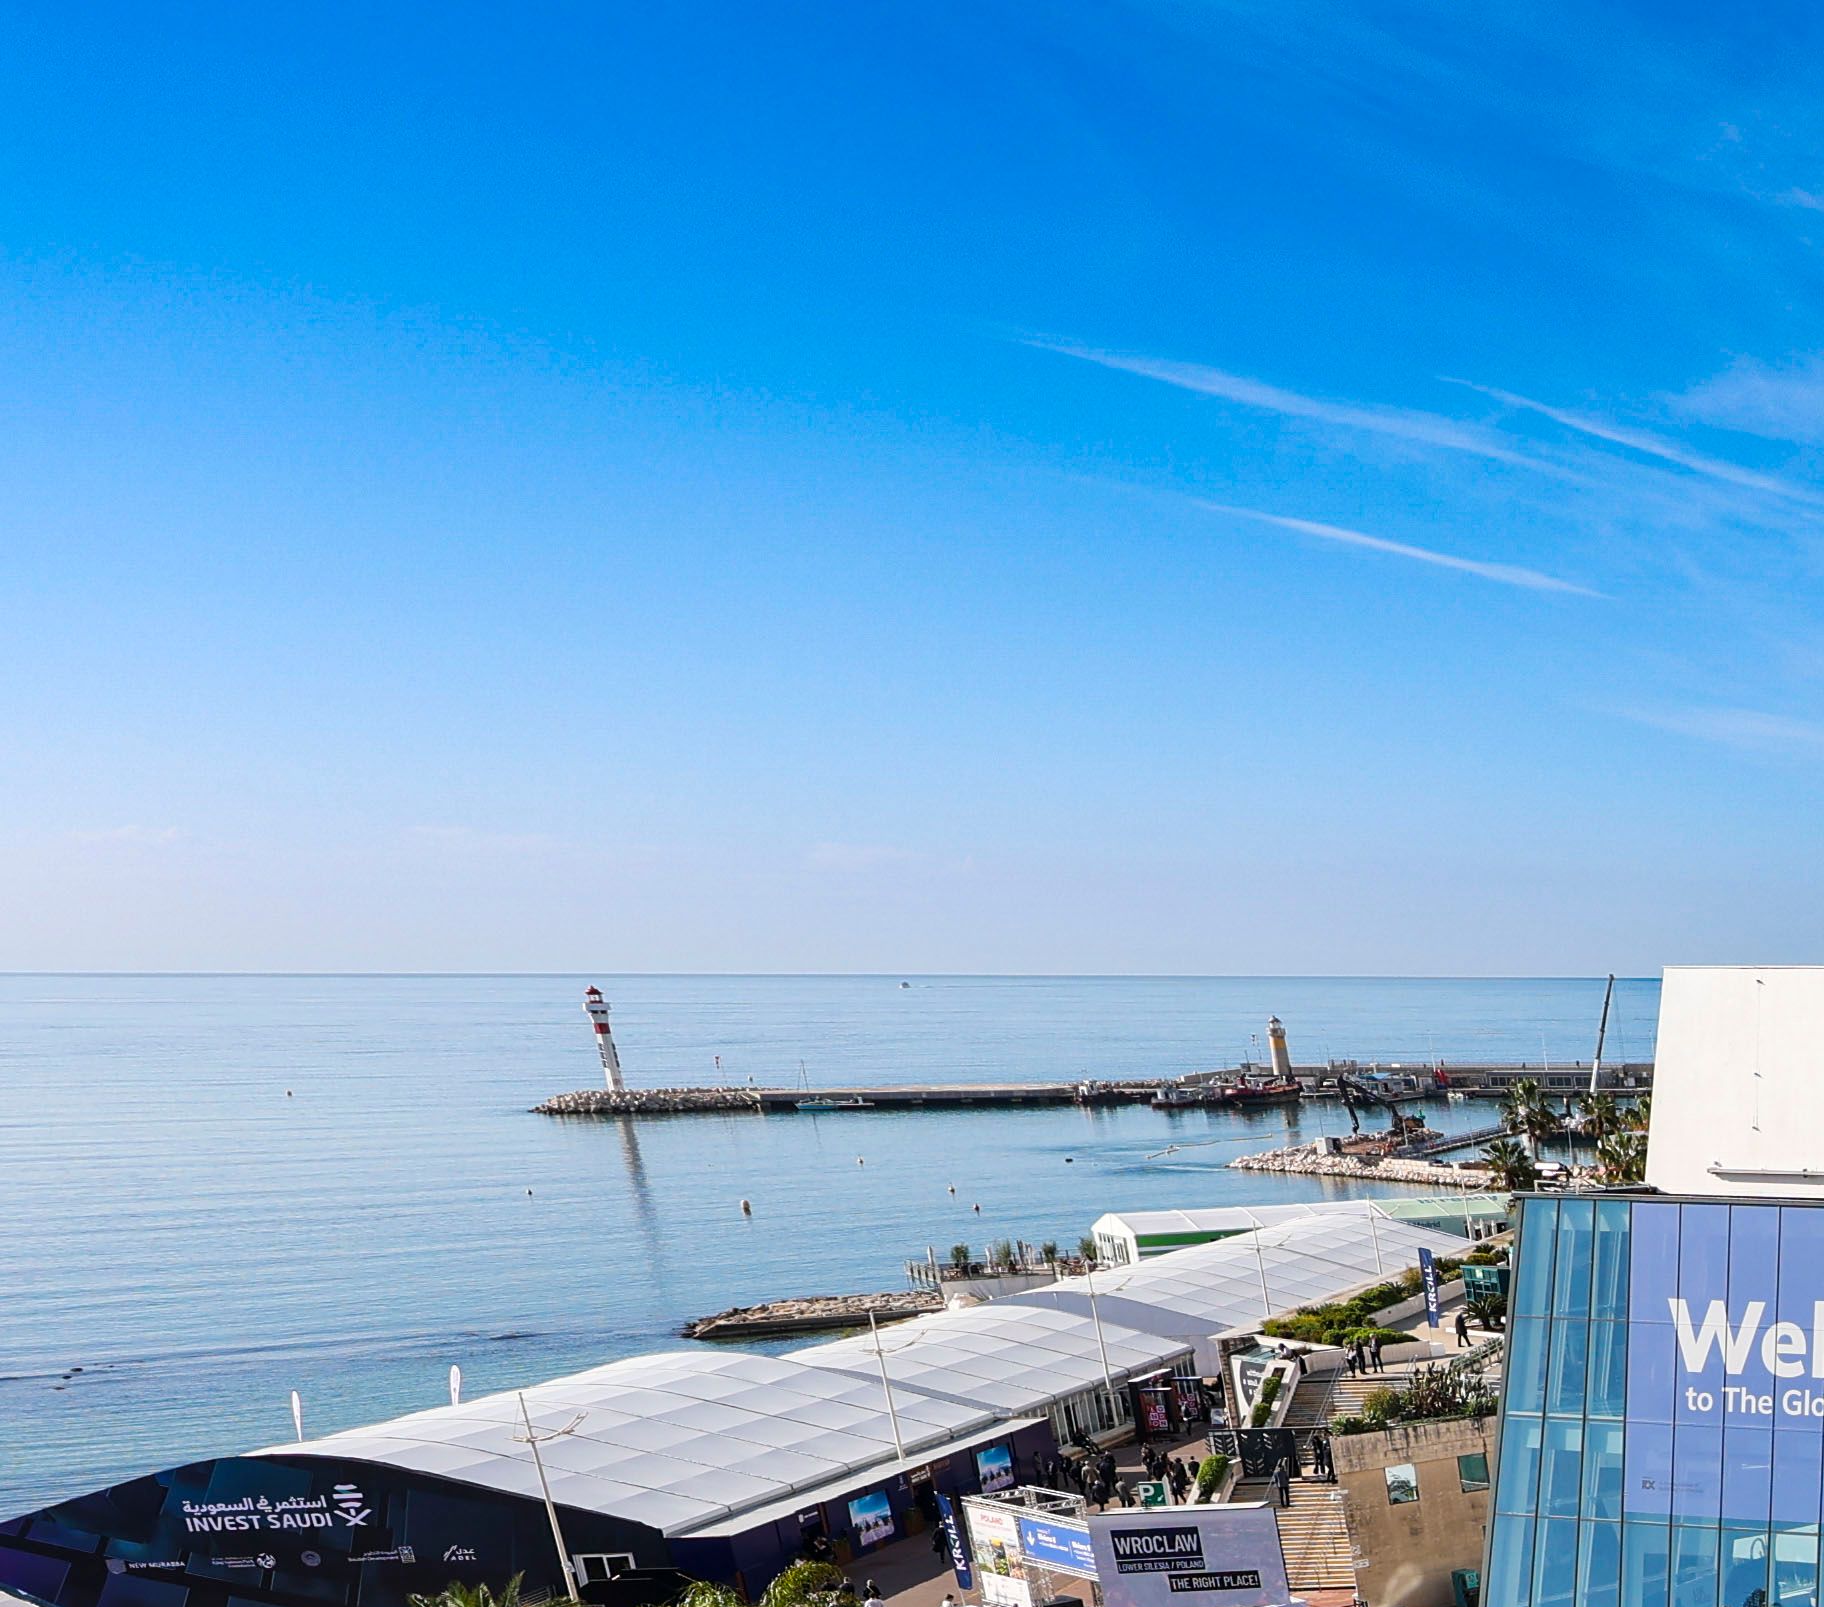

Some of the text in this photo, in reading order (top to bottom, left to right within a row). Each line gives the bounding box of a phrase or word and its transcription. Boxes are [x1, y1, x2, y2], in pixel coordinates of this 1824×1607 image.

[1686, 1388, 1713, 1412] to
[1722, 1387, 1773, 1415] The
[1140, 1485, 1155, 1500] P
[183, 1498, 253, 1515] السعودية
[275, 1495, 327, 1512] استثمر
[186, 1513, 333, 1532] INVEST SAUDI
[1114, 1534, 1198, 1555] WROCLAW
[1118, 1562, 1143, 1572] LOWER
[1144, 1561, 1170, 1571] SILESIA
[1176, 1559, 1204, 1569] POLAND
[1171, 1574, 1259, 1590] THE RIGHT PLACE!
